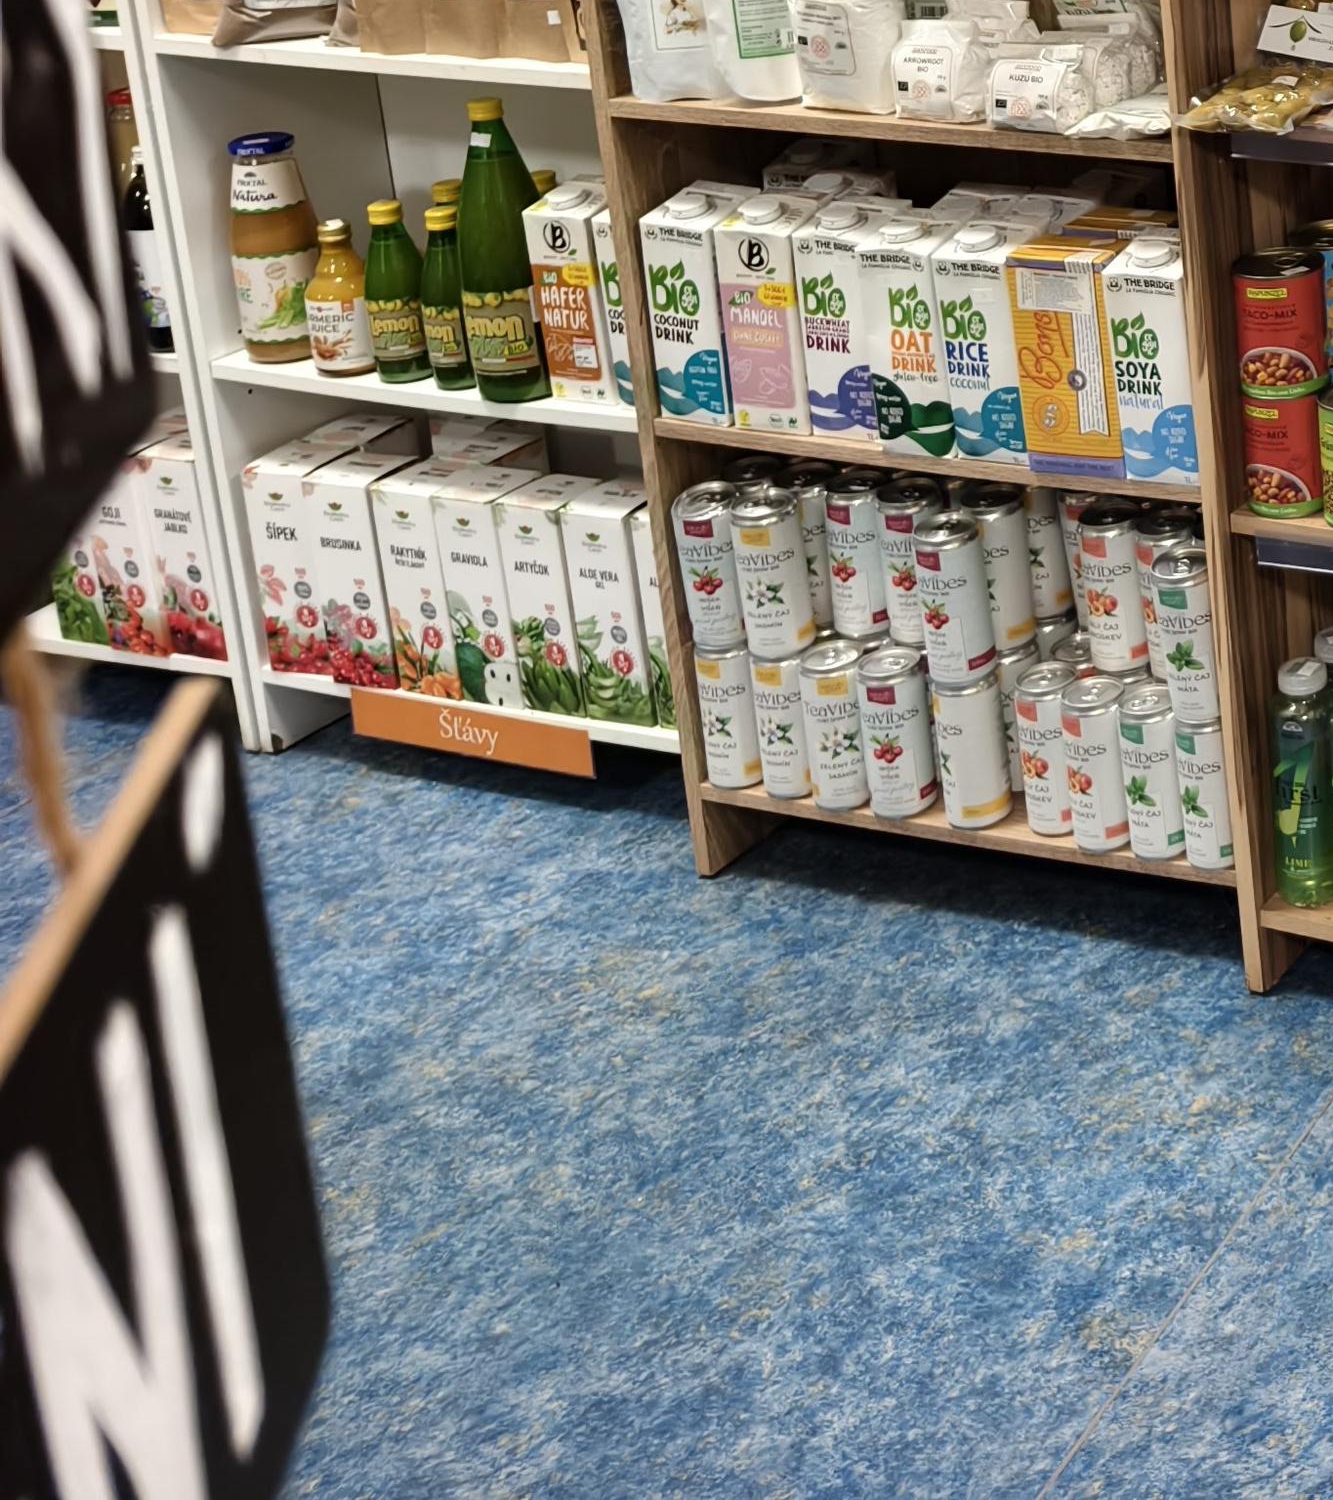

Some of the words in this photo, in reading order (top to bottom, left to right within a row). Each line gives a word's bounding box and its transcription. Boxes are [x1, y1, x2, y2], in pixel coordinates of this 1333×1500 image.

[1009, 73, 1030, 83] KUZU
[1124, 277, 1143, 289] THE
[1145, 280, 1175, 293] BRIDGE
[541, 285, 586, 310] HAFER
[543, 308, 589, 332] NATUR
[654, 313, 699, 332] COCONUT
[730, 307, 783, 327] MANDEL
[656, 327, 694, 345] DRINK
[806, 334, 851, 354] DRINK
[891, 329, 933, 350] OAT
[944, 341, 988, 363] RICE
[892, 355, 936, 373] DRINK
[948, 361, 991, 378] DRINK
[1115, 360, 1161, 380] SOYA
[1118, 377, 1163, 396] DRINK
[266, 523, 297, 543] ŠÍPEK
[320, 536, 361, 553] BRUSINKA
[389, 544, 427, 563] RAKYTNÍK
[451, 551, 488, 568] GRAVIOLA
[514, 560, 550, 577] ARTYČOK
[579, 568, 599, 582] ALOE
[602, 570, 620, 584] VERA
[439, 707, 499, 756] Šťávy
[1284, 856, 1312, 871] LIME
